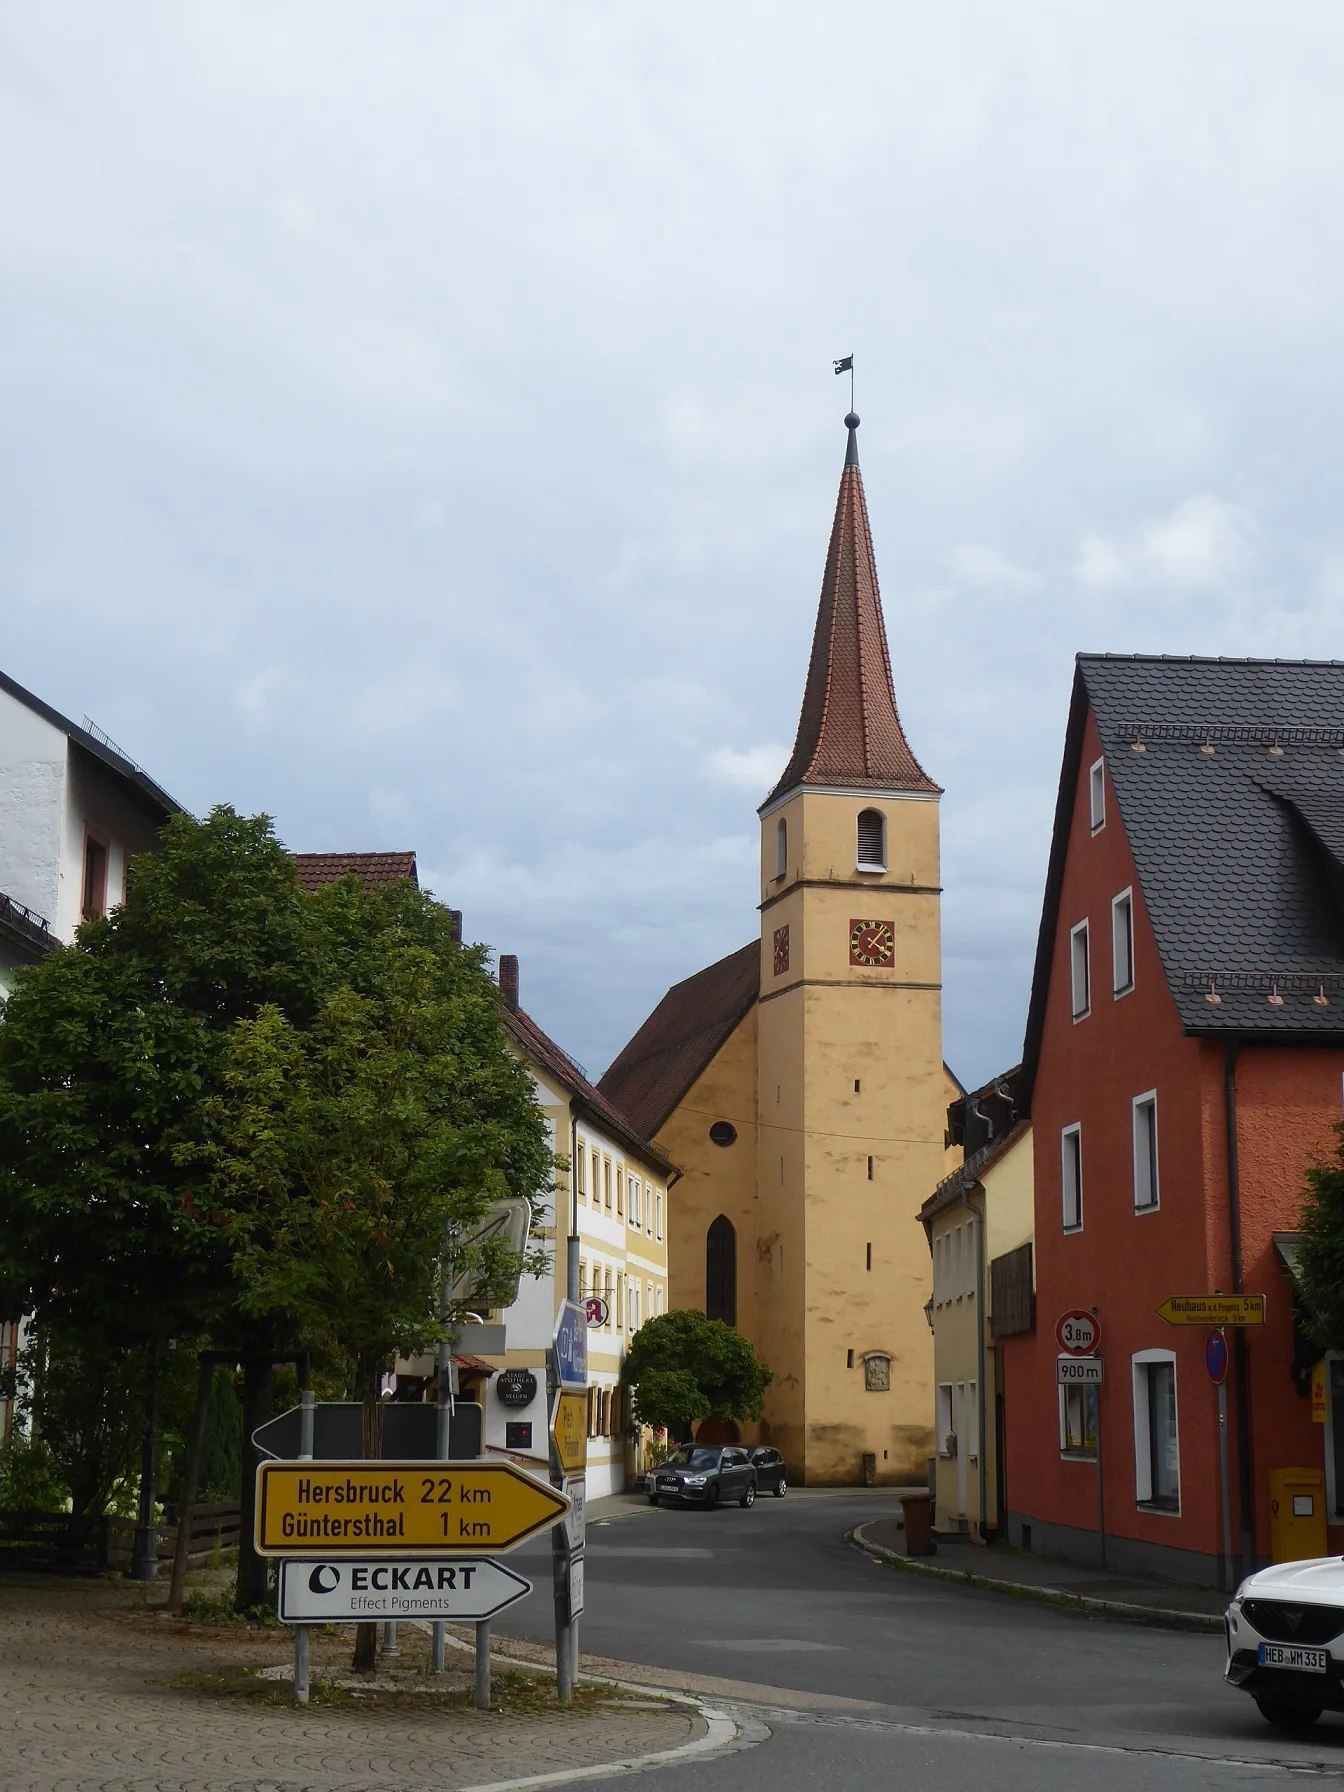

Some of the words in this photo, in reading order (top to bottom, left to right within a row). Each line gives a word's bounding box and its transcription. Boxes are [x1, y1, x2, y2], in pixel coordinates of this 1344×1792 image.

[1171, 1299, 1207, 1312] Neuhaus
[1243, 1298, 1249, 1311] 5
[1250, 1300, 1262, 1311] km
[1061, 1365, 1085, 1378] 900
[1086, 1368, 1098, 1378] m
[297, 1478, 405, 1504] Hersbruck
[420, 1478, 453, 1503] 22
[460, 1484, 491, 1503] km
[282, 1511, 405, 1537] Güntersthal
[440, 1512, 449, 1537] 1
[459, 1517, 491, 1536] km
[351, 1567, 477, 1591] ECKART
[350, 1596, 387, 1610] Effect
[391, 1596, 449, 1612] Pigments
